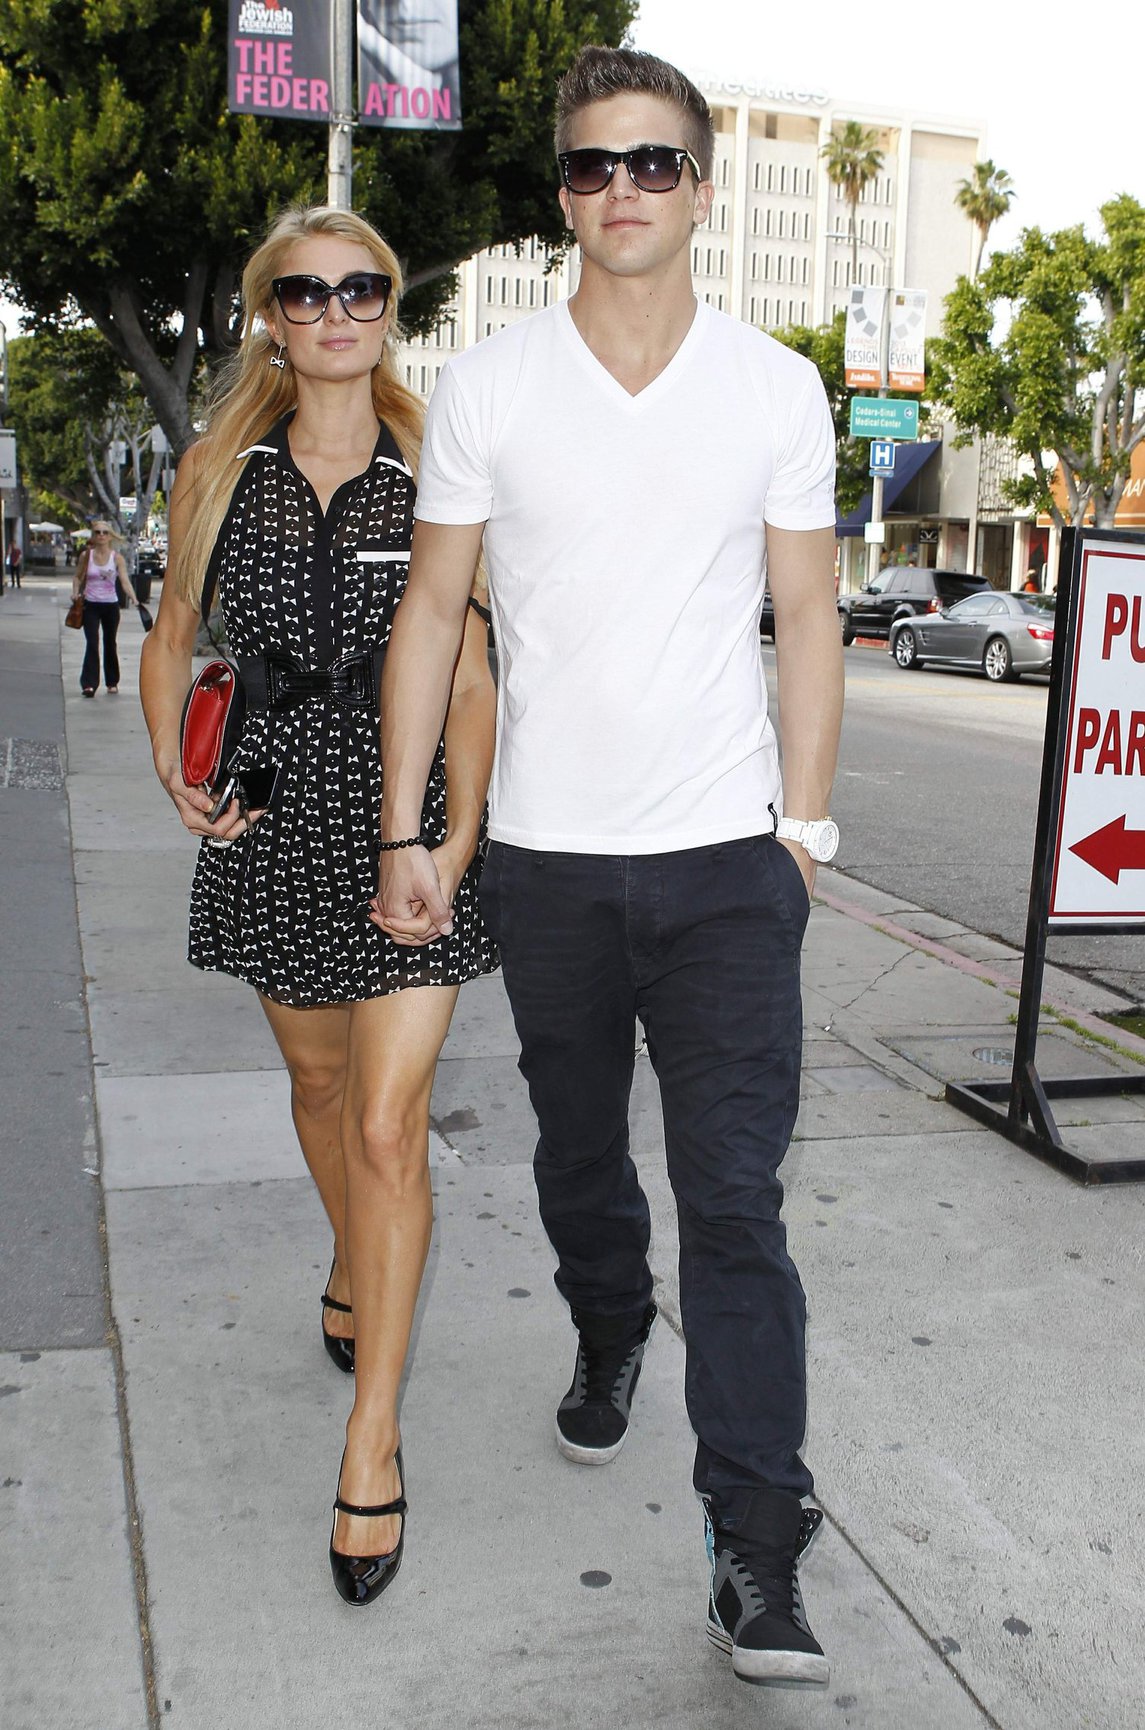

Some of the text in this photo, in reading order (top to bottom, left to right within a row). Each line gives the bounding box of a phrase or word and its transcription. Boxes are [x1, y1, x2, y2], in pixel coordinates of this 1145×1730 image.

[239, 4, 293, 23] Jewish
[239, 20, 293, 31] FEDERATION
[234, 40, 292, 75] THE
[236, 74, 328, 112] FEDER
[364, 84, 450, 119] ATION
[846, 350, 878, 364] DESIGN
[890, 352, 918, 366] EVENT
[855, 417, 902, 428] Medical Center
[875, 445, 890, 465] H
[1073, 708, 1145, 776] PAR
